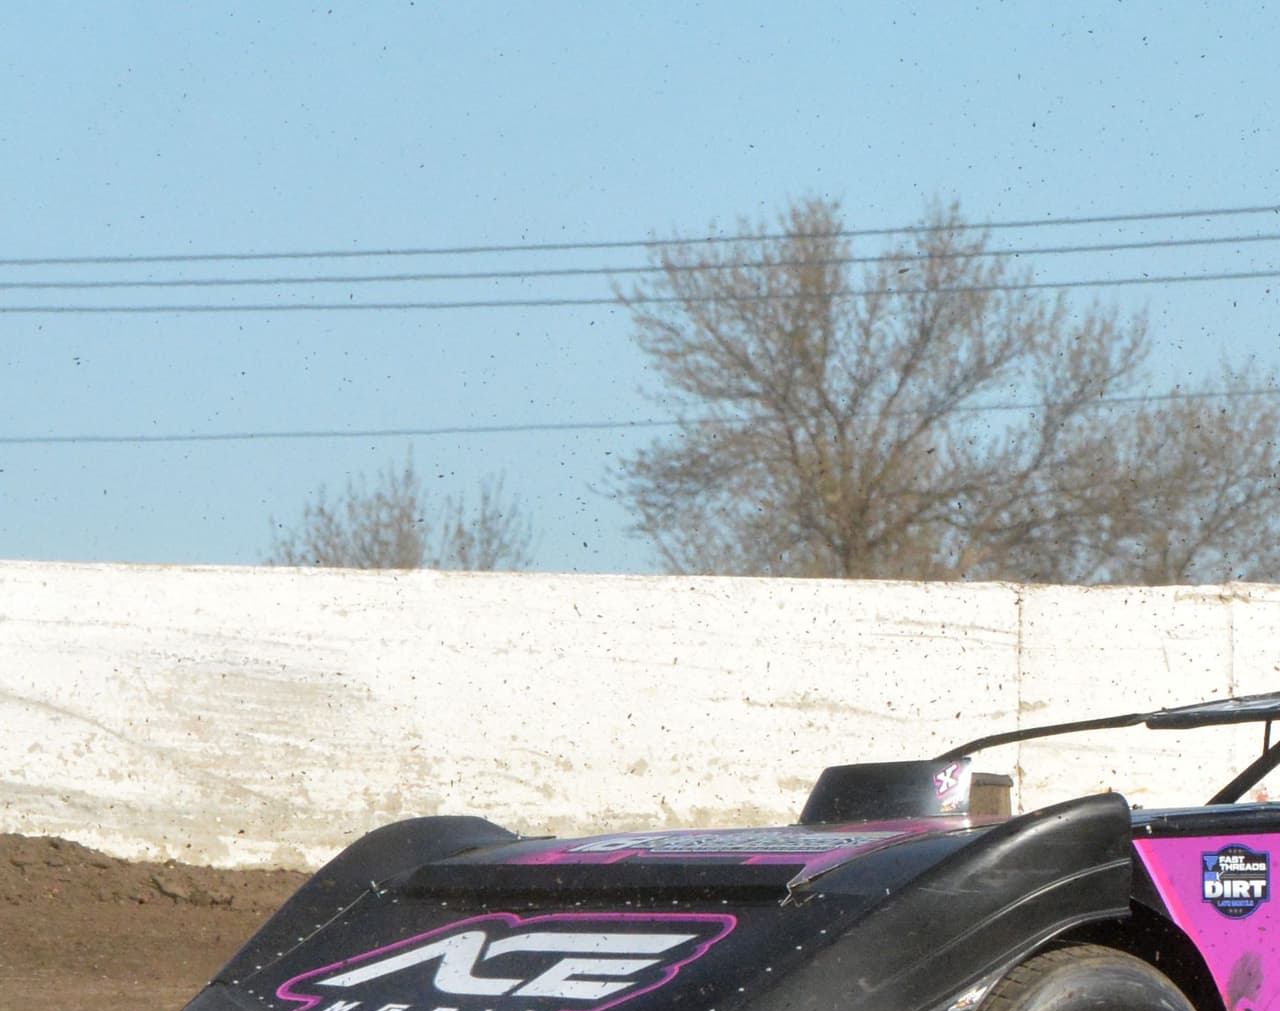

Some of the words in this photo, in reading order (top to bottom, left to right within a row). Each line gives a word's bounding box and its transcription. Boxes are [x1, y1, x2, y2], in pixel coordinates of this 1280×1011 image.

[1218, 855, 1245, 864] FAST
[1219, 863, 1267, 872] THREADS
[1204, 880, 1267, 898] DIRT
